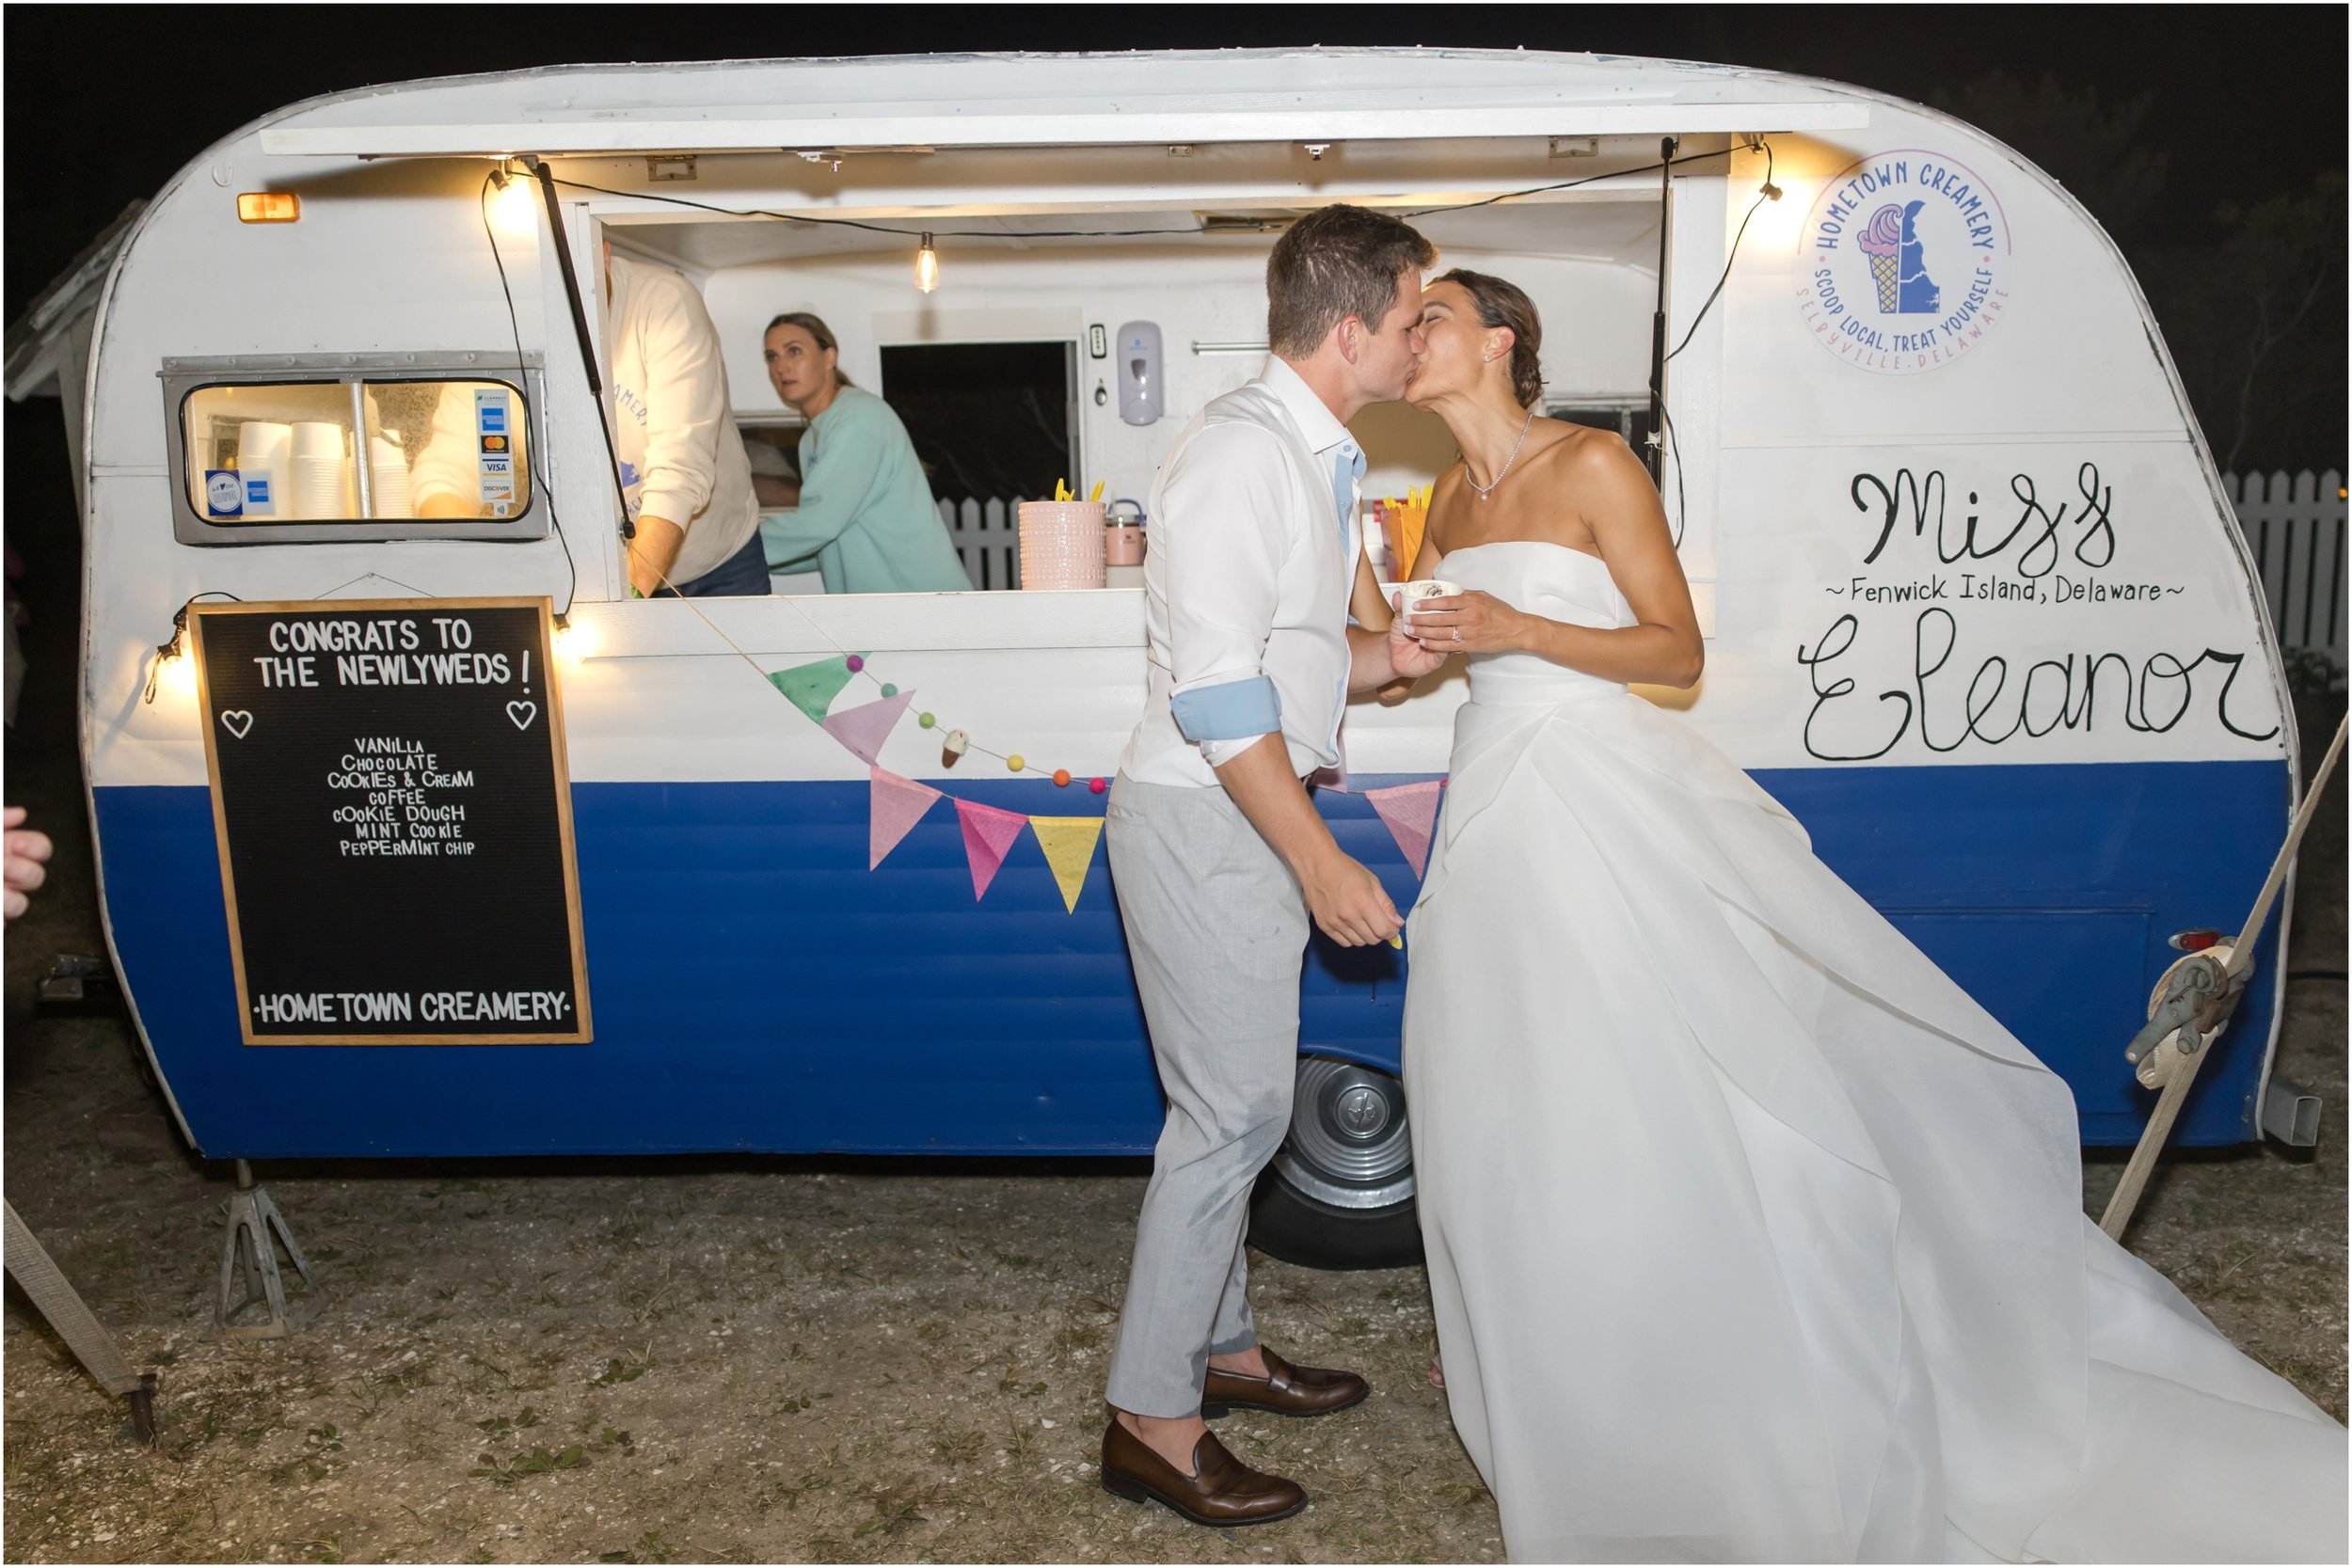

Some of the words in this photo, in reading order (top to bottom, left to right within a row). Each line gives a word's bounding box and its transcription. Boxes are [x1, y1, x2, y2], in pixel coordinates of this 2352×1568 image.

[1817, 161, 1907, 249] HOMETOWN
[1919, 163, 1994, 249] CREAMERY
[1815, 269, 1844, 316] SCOOP
[1839, 315, 1888, 353] LOCAL,
[1893, 328, 1938, 353] TREAT
[1940, 267, 1994, 337] YOURSELF
[1917, 289, 2010, 368] DELAWARE
[1851, 462, 2115, 578] Miss
[1851, 575, 1948, 604] Fenwick
[1960, 575, 2046, 605] Island,
[2055, 575, 2161, 603] Delaware
[269, 619, 420, 652] CONGRATS
[432, 618, 471, 649] TO
[253, 657, 319, 688] THE
[1798, 608, 2280, 761] Eleanor
[342, 754, 438, 771] CHOCOLATE
[404, 771, 416, 788] &
[421, 770, 474, 787] CREAM
[369, 789, 425, 805] COFFEE
[405, 805, 466, 822] DOUGH
[356, 823, 401, 839] MINT
[340, 840, 440, 856] PEPPERMINT
[445, 842, 475, 855] CHIP
[259, 992, 412, 1022] HOMETOWN
[420, 991, 565, 1022] CREAMERY
